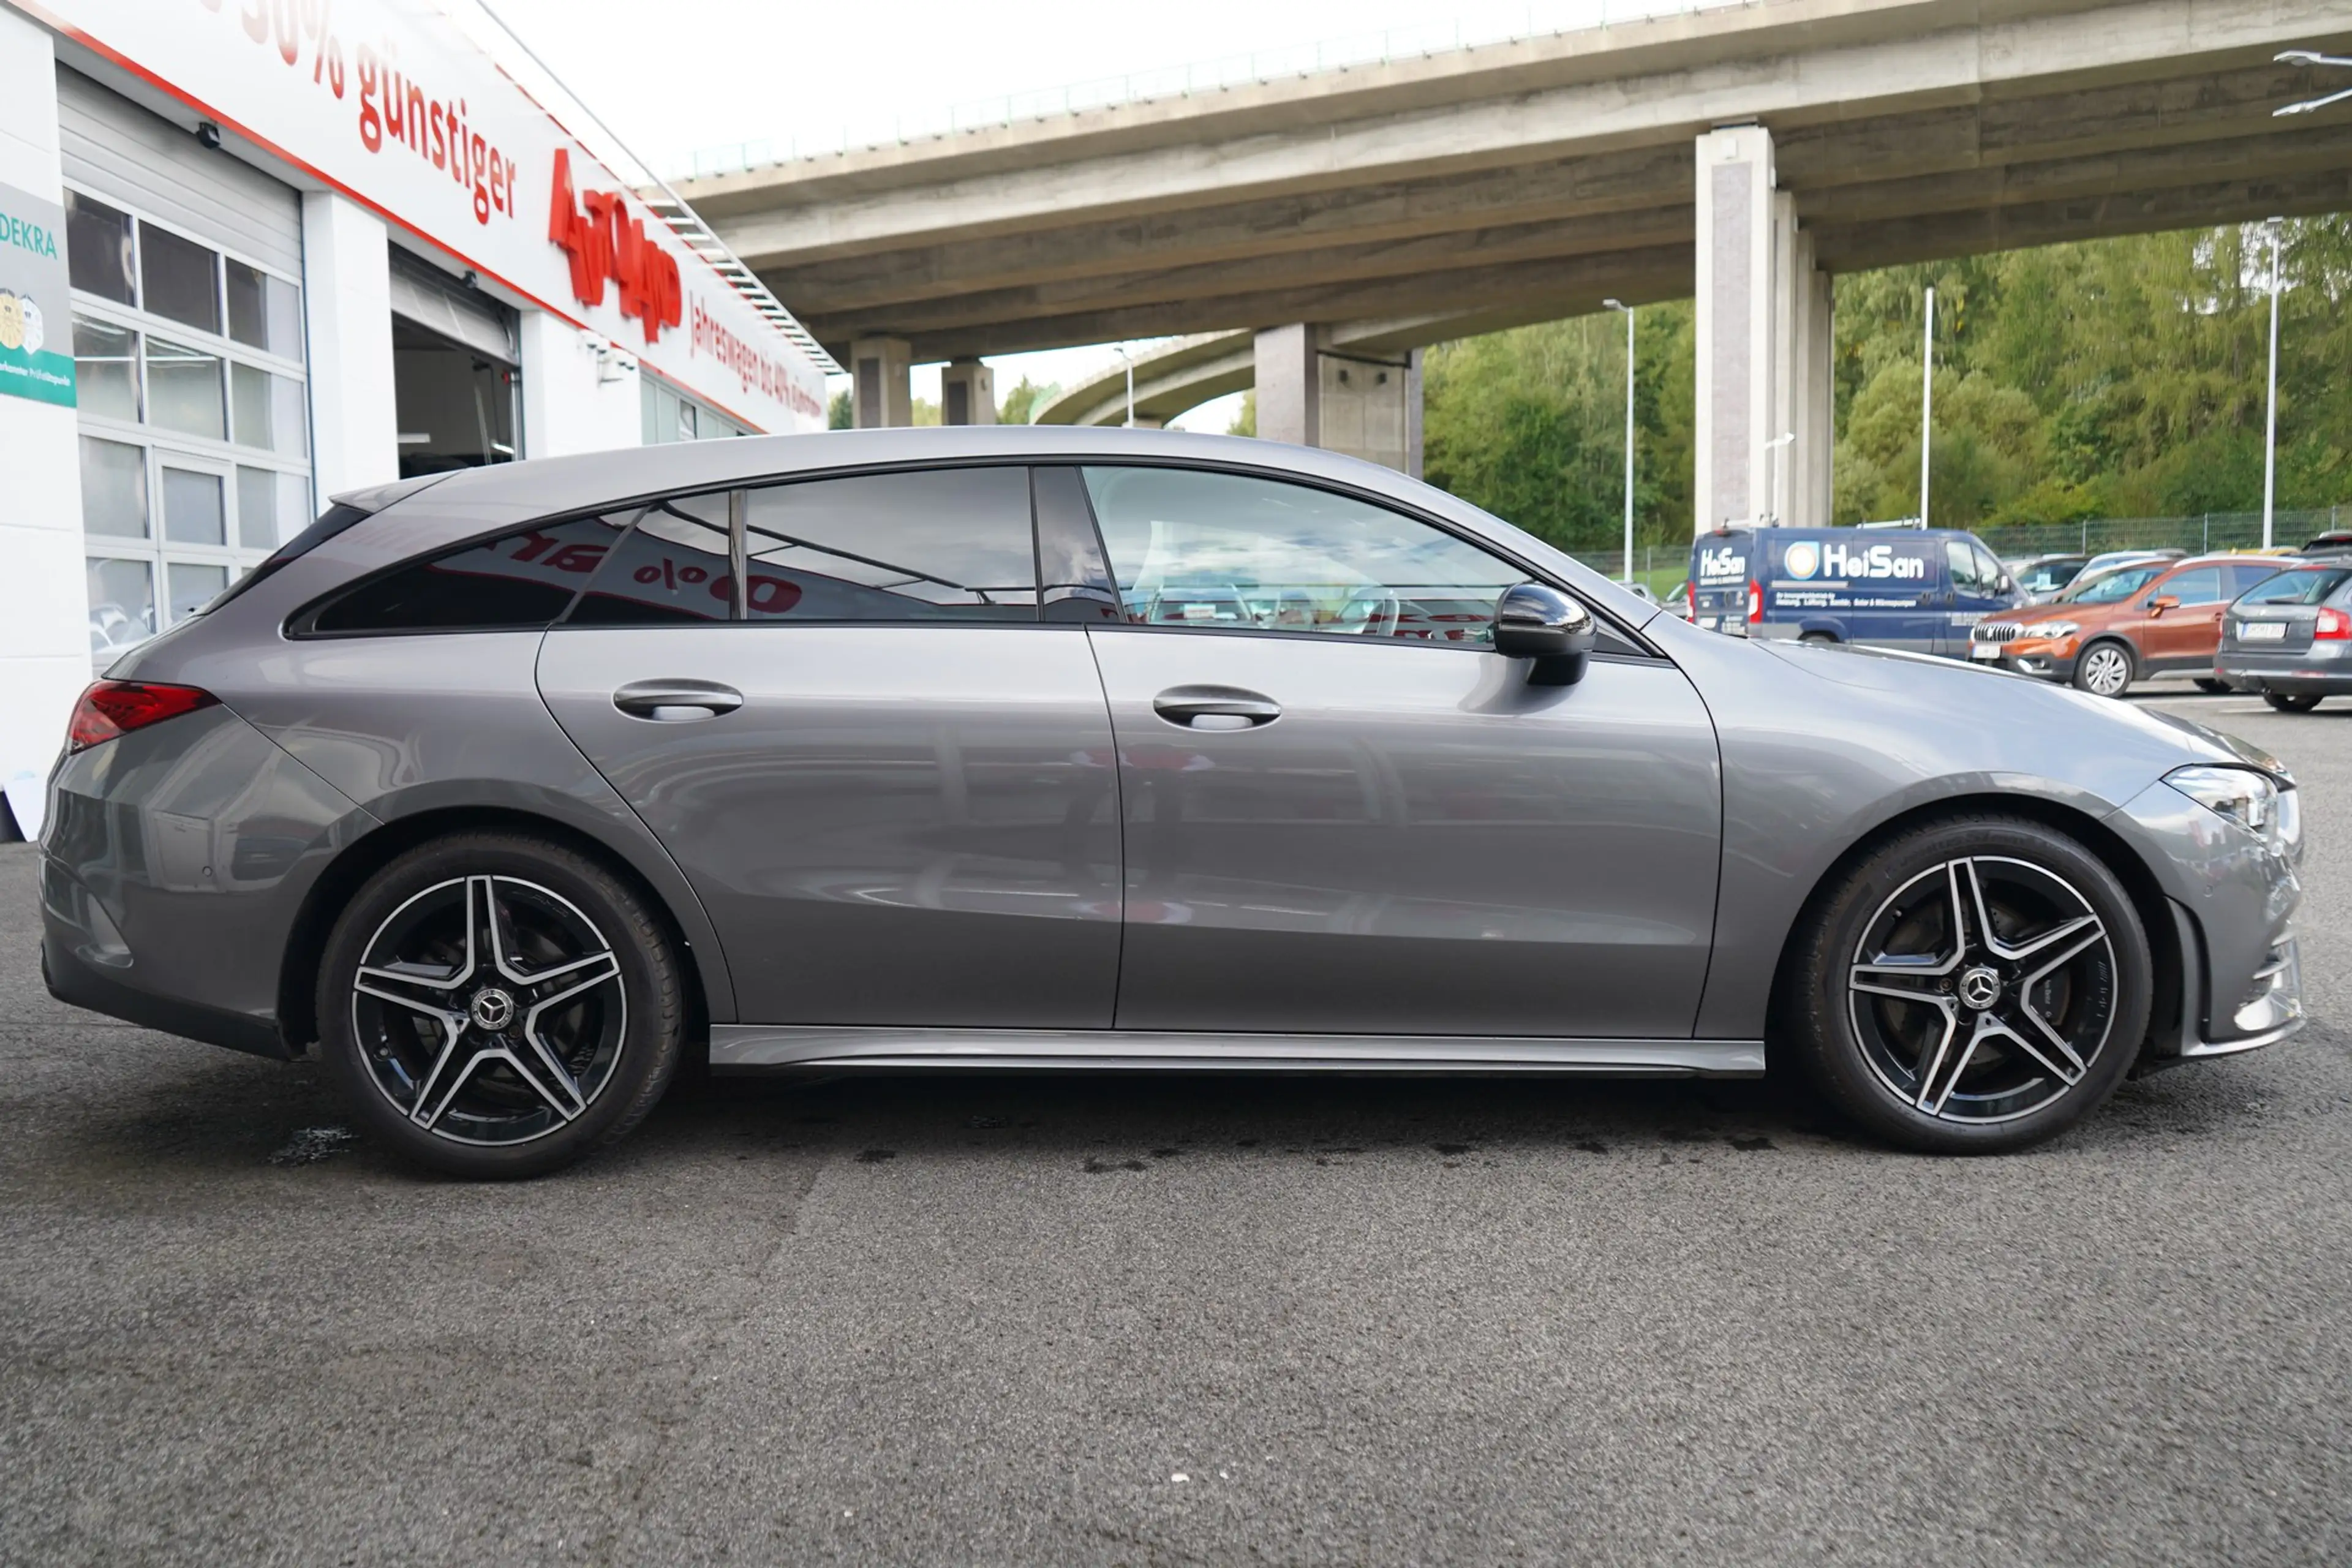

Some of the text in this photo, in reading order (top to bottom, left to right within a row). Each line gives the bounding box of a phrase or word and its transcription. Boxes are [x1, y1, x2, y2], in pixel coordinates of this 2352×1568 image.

[358, 34, 516, 226] günstiger
[0, 212, 58, 260] DEKRA
[1823, 544, 1924, 578] HeiSan
